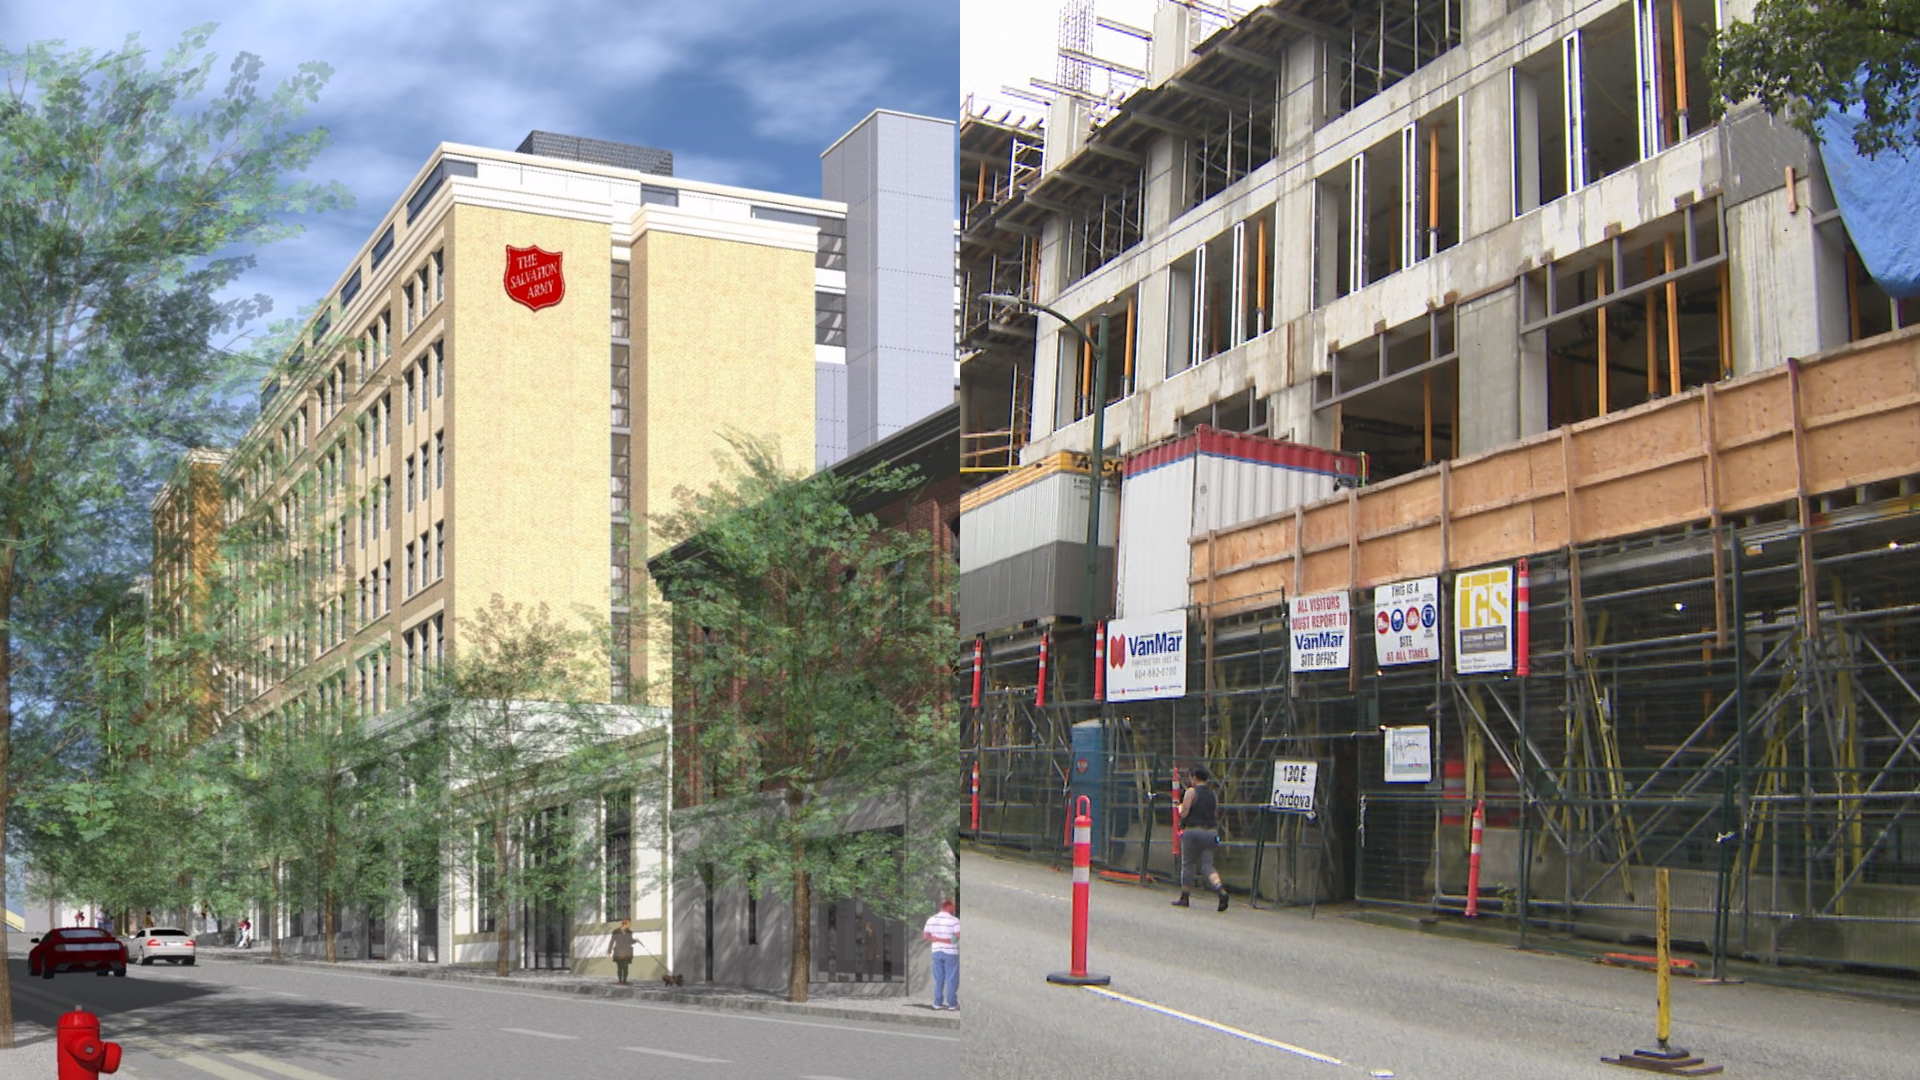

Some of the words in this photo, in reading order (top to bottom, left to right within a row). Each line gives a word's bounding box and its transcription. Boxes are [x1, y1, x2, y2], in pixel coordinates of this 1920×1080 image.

[516, 253, 538, 270] THE
[510, 261, 558, 290] SALVATION
[527, 279, 554, 300] ARMY
[1392, 584, 1405, 598] THIS
[1406, 583, 1414, 594] IS
[1415, 582, 1420, 594] A
[1298, 599, 1309, 614] ALL
[1310, 596, 1340, 612] VISITORS
[1292, 616, 1310, 631] MUST
[1312, 613, 1336, 628] REPORT
[1339, 611, 1348, 626] TO
[1128, 632, 1182, 656] VanMar
[1295, 631, 1344, 650] VanMar
[1399, 635, 1412, 648] SITE
[1301, 653, 1315, 668] SITE
[1316, 651, 1338, 667] OFFICE
[1386, 651, 1394, 662] AT
[1395, 650, 1407, 662] ALL
[1408, 648, 1429, 659] TIMES
[1284, 765, 1299, 782] 130
[1300, 765, 1307, 782] E
[1273, 790, 1310, 808] Cordova
